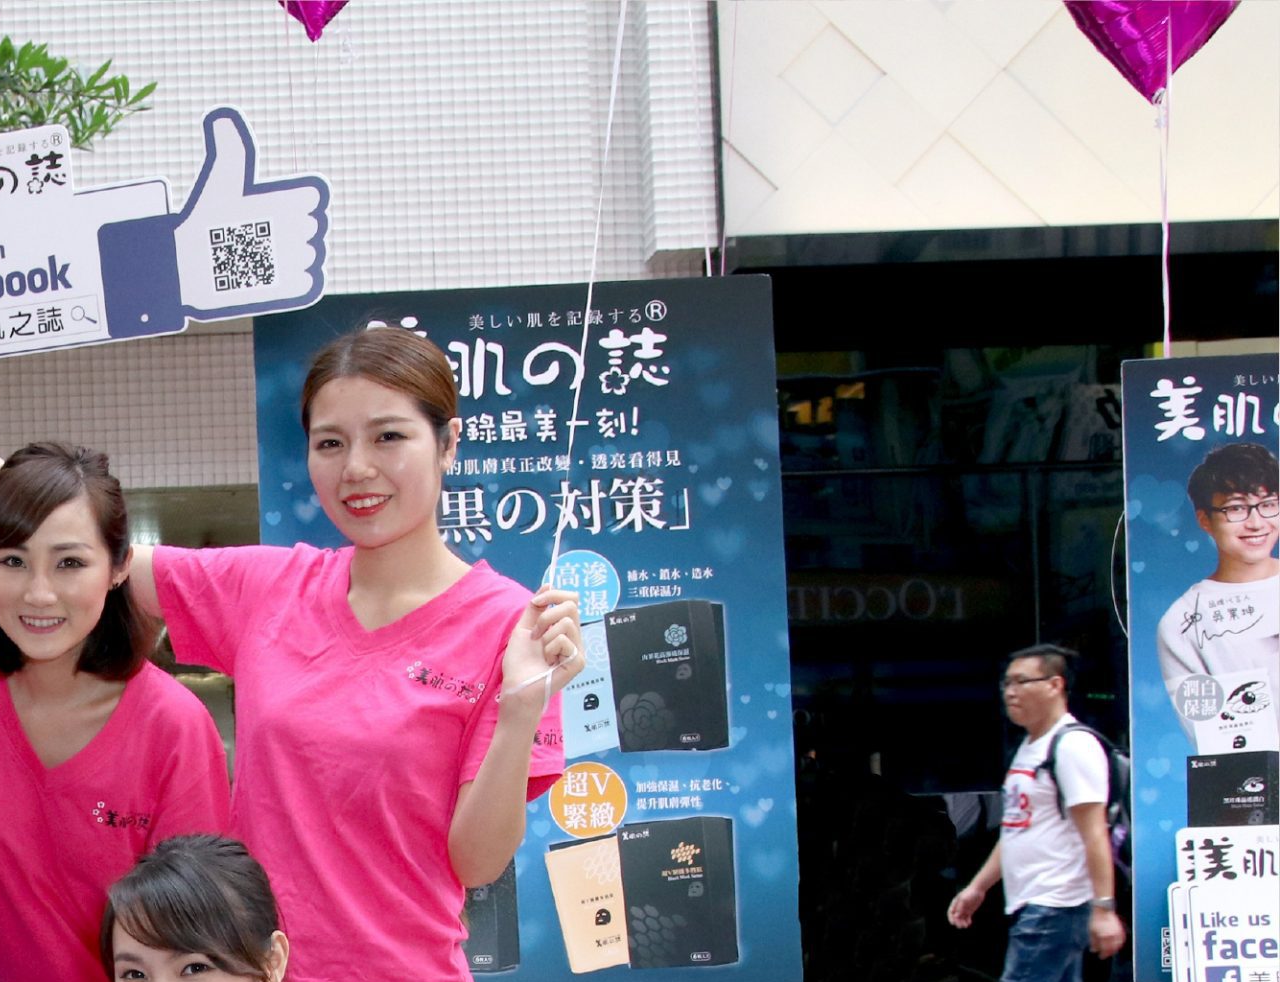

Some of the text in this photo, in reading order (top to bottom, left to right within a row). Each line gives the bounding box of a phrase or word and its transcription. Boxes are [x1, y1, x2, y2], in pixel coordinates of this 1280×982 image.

[628, 584, 682, 598] 三重保濕力
[577, 590, 610, 617] 濕
[564, 772, 613, 797] 超V
[636, 796, 703, 811] 提升肌膚彈性
[564, 803, 616, 829] 緊緻
[1200, 911, 1270, 928] Like us
